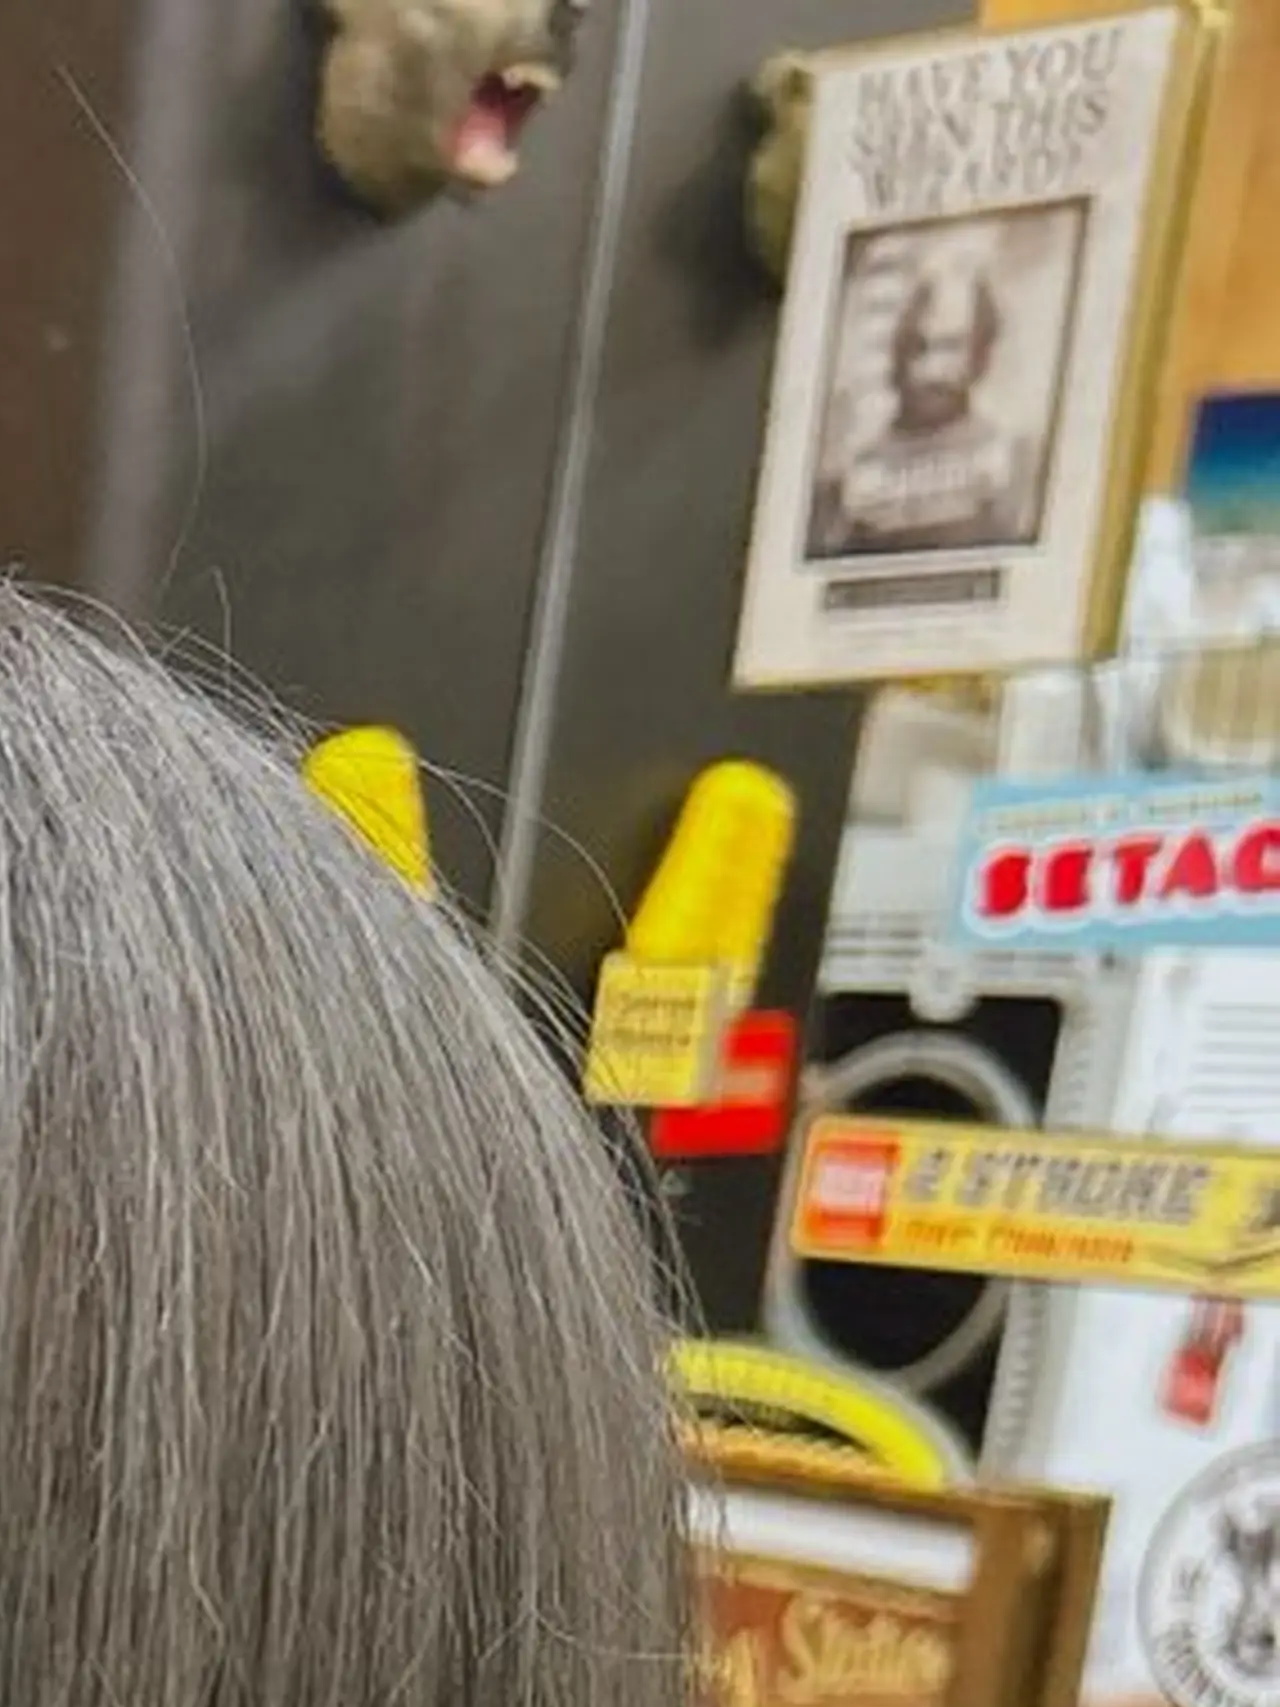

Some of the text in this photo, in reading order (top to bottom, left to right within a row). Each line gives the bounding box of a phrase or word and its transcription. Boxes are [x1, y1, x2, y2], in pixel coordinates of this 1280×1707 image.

[1003, 26, 1124, 100] YOU
[988, 88, 1108, 150] THIS
[953, 1149, 1211, 1226] STROKE
